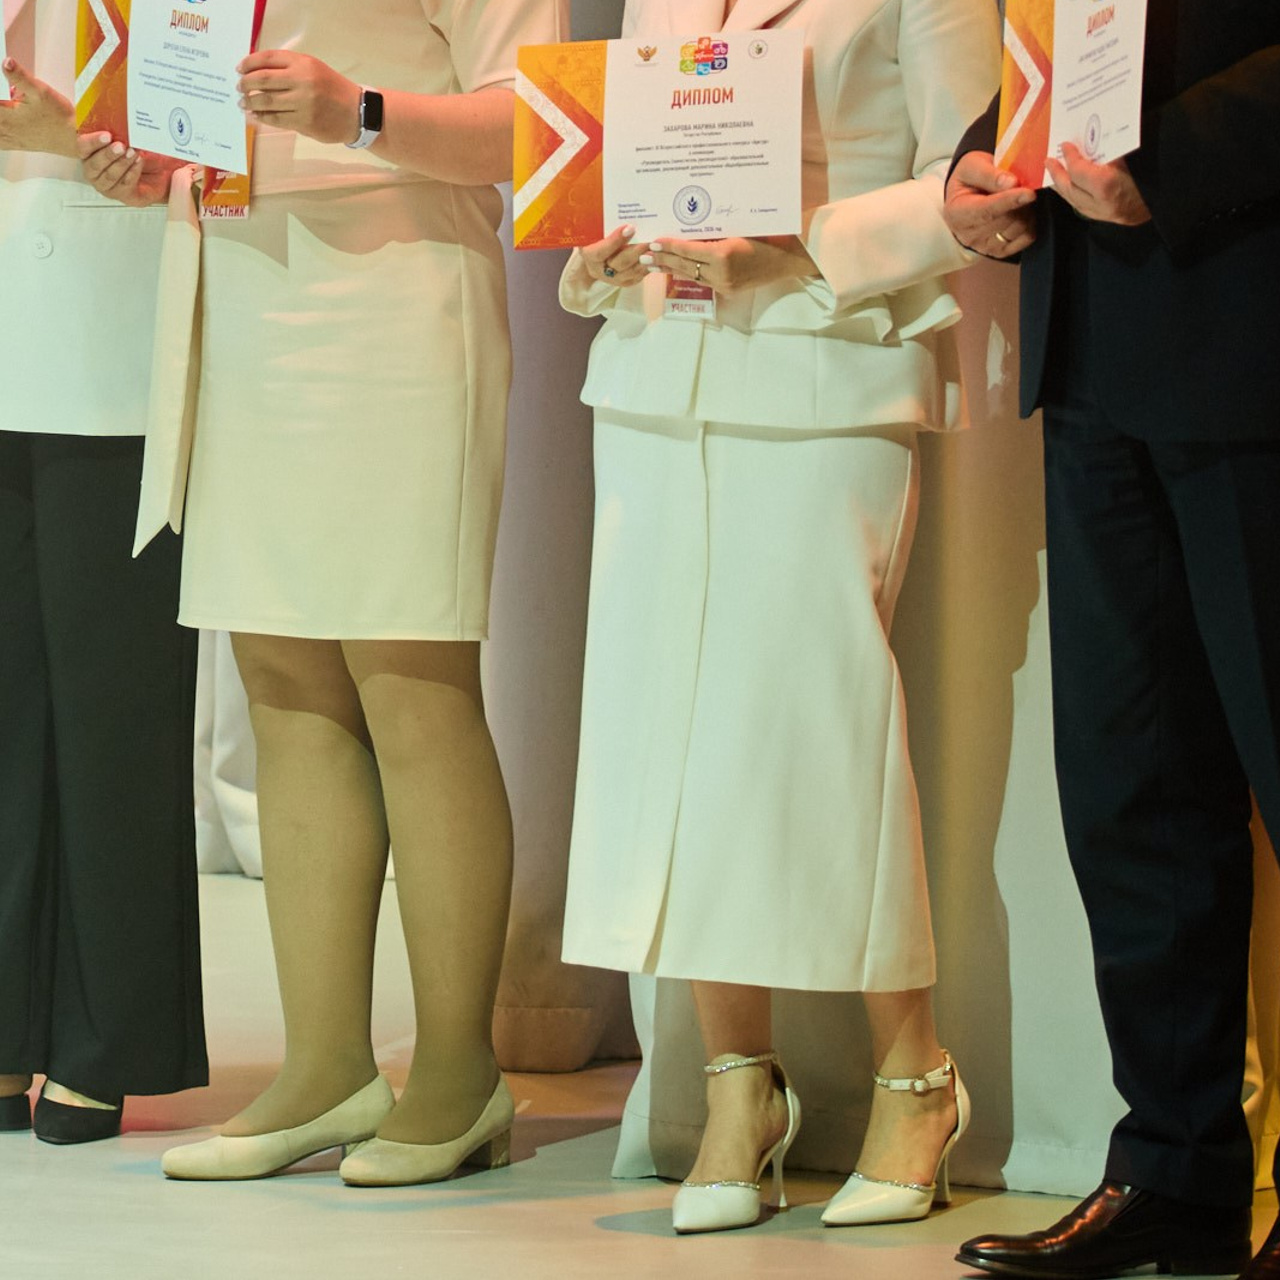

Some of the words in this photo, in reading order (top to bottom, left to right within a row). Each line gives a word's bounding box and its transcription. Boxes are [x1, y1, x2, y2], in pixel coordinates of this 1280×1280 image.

[170, 9, 210, 33] ДИПЛОМ
[1086, 4, 1115, 38] ДИПЛОМ
[671, 87, 734, 109] ДИПЛОМ
[693, 122, 716, 131] МАРИНА
[203, 205, 245, 218] УЧАСТНИК
[671, 302, 706, 313] УЧАСТНИК
